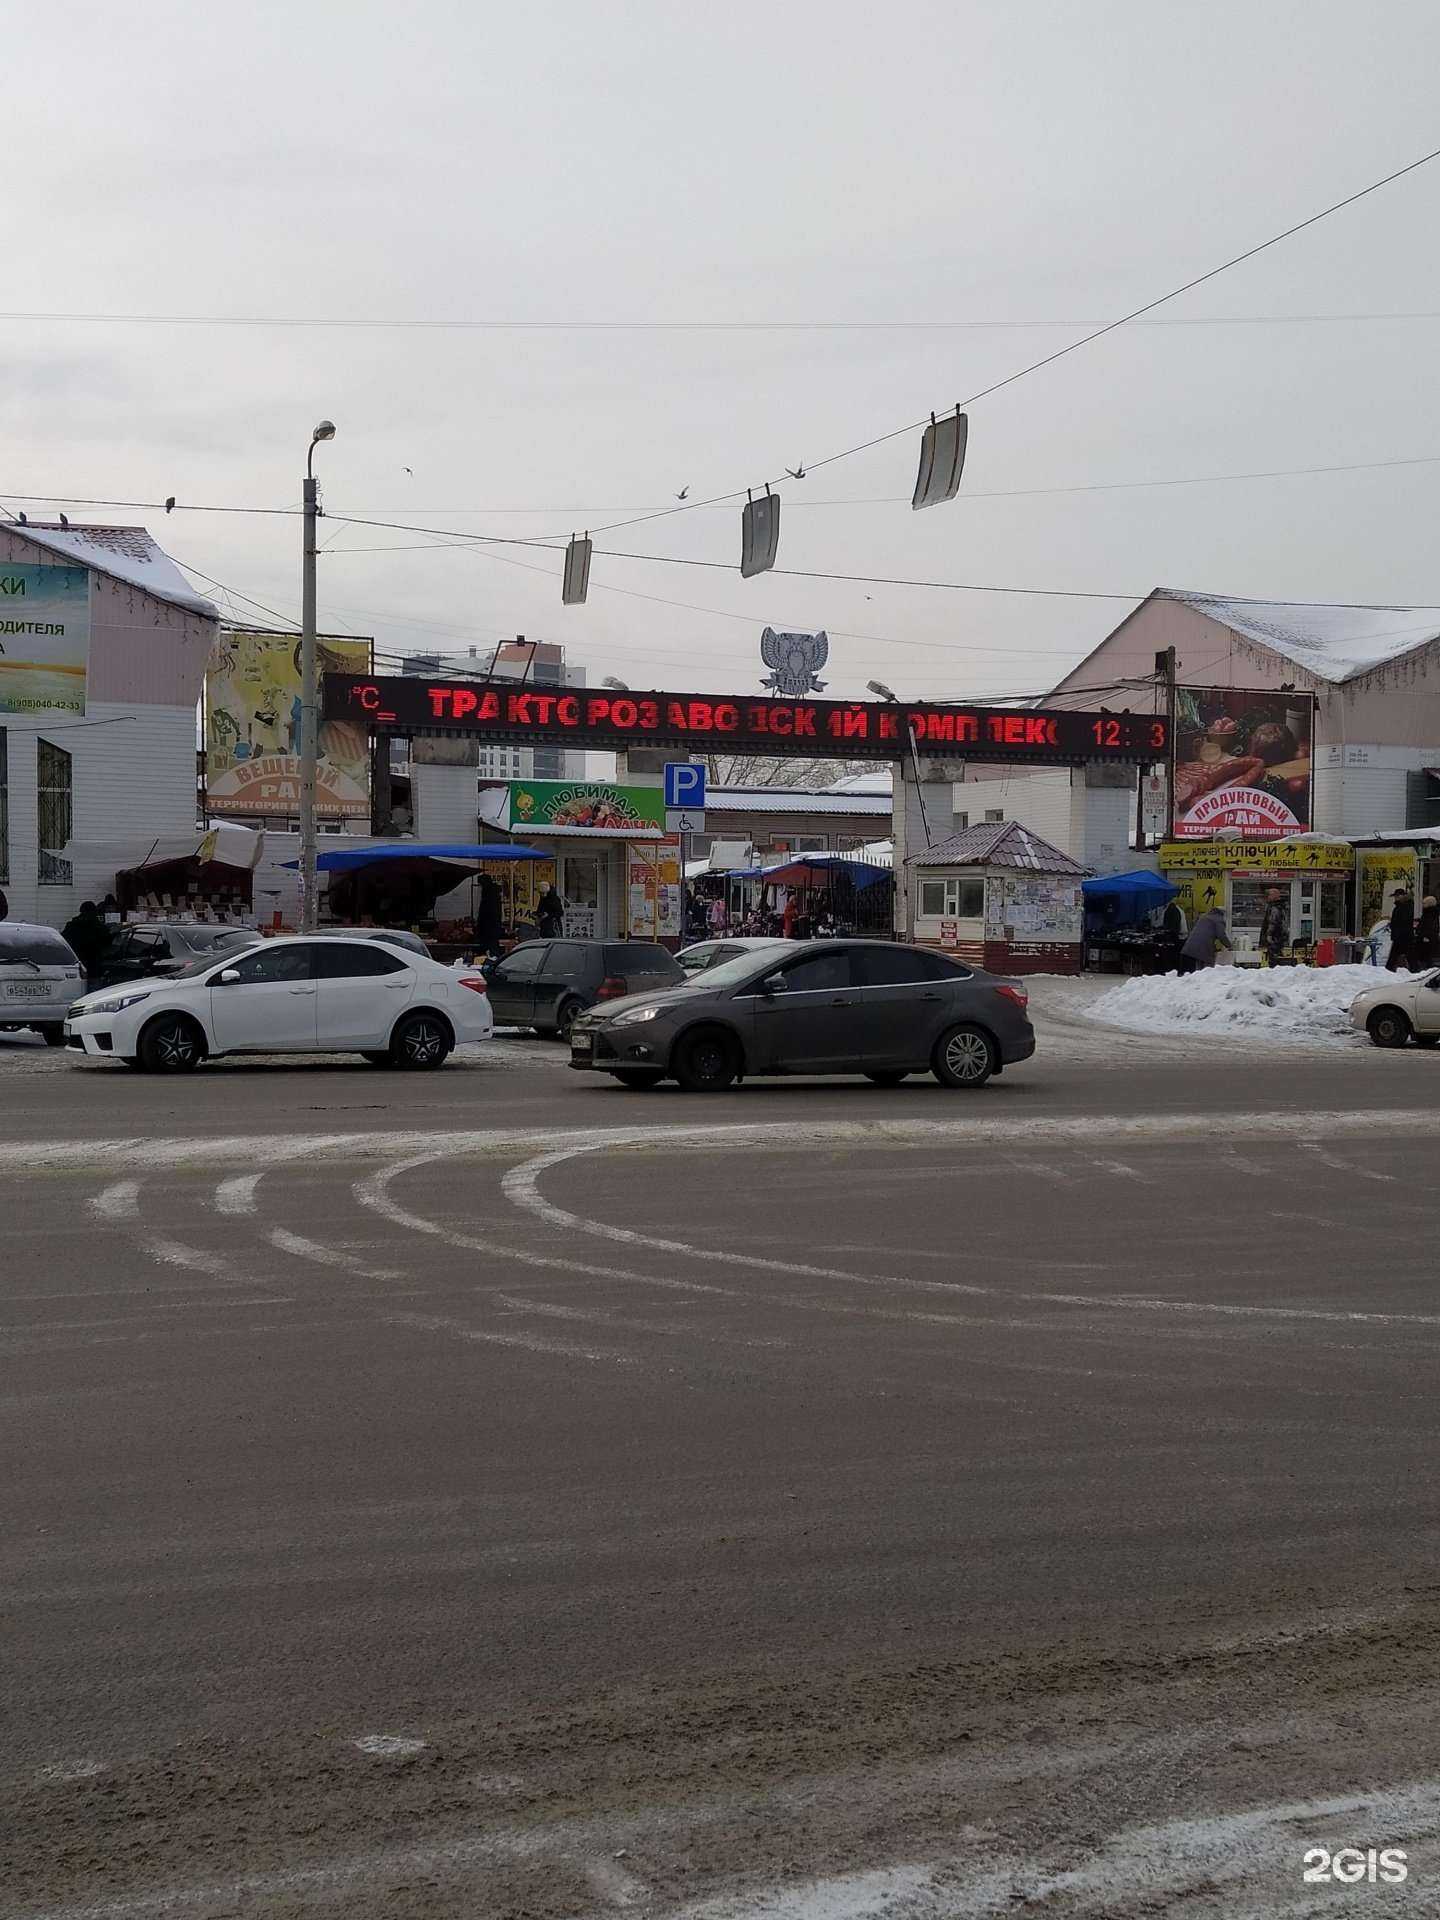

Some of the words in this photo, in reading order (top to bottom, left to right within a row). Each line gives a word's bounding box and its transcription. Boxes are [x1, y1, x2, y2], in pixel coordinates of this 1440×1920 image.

[235, 757, 341, 788] ВЕЩЕОЙ
[260, 781, 301, 799] РА
[673, 766, 698, 805] P
[289, 803, 340, 813] НКИХ
[542, 784, 641, 821] ЛЮБИМАЯ
[1194, 791, 1290, 823] ПРОДУКТОВЫЙ
[1225, 810, 1261, 825] РАЙ
[1183, 825, 1242, 835] ТЕРРИТ
[1225, 845, 1278, 858] КЛЮЧИ
[1269, 859, 1301, 868] ЛЮБЫЕ
[1196, 870, 1224, 880] КЛЮЧИ
